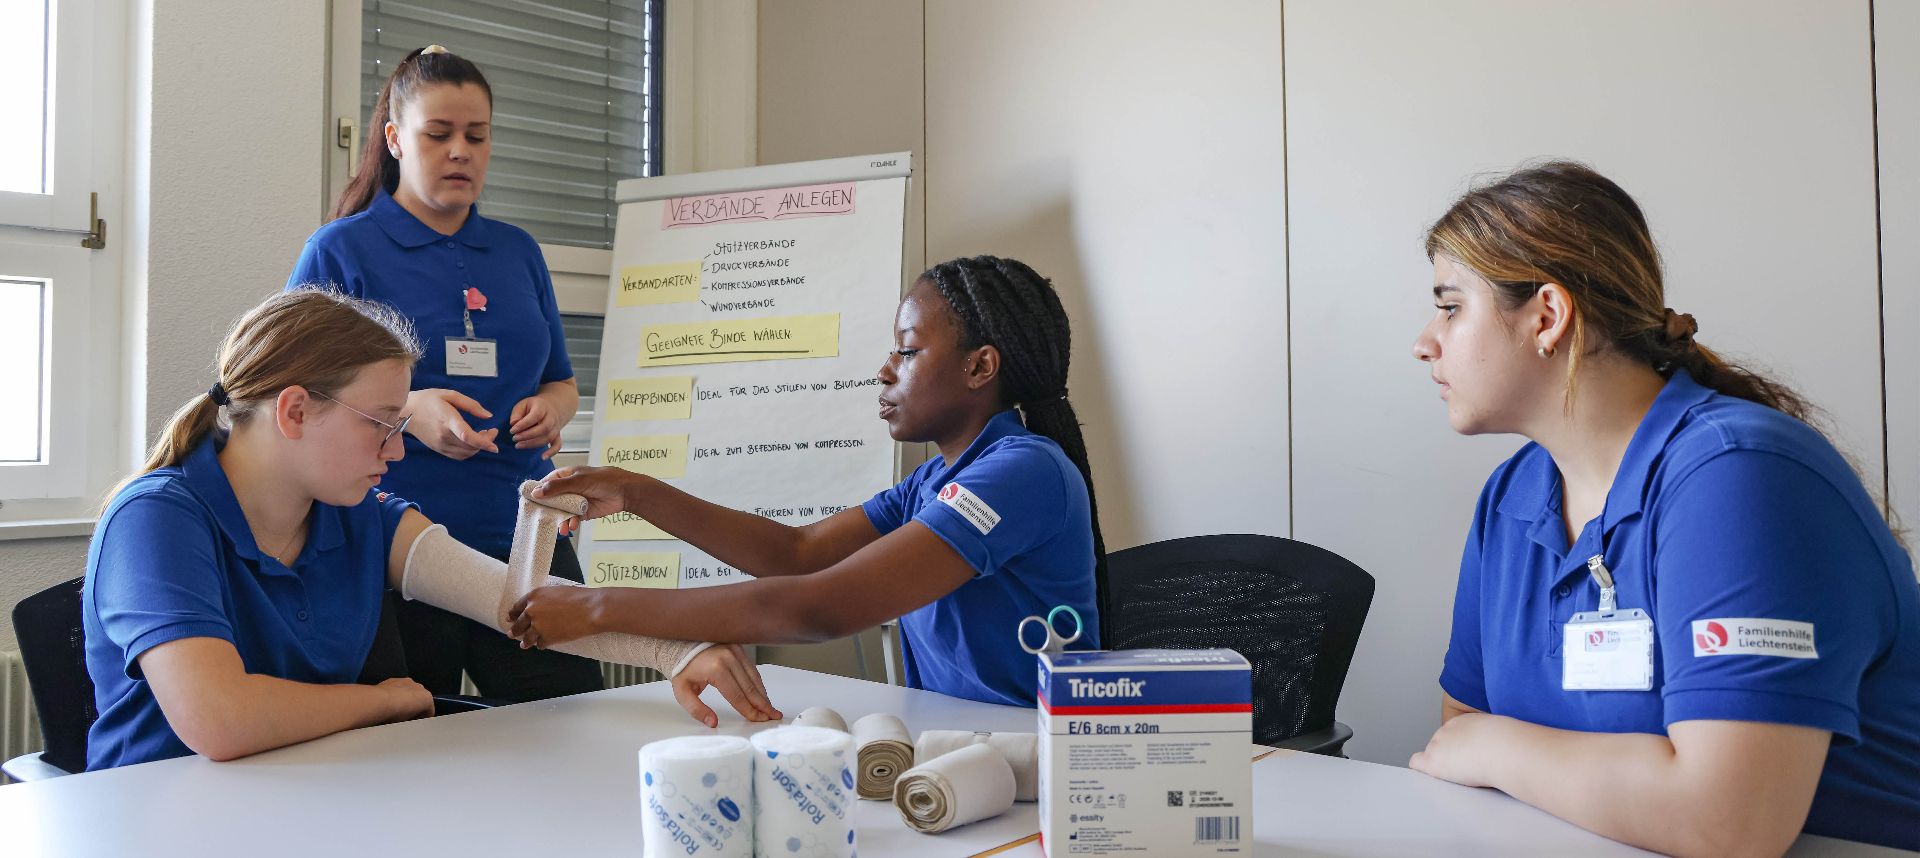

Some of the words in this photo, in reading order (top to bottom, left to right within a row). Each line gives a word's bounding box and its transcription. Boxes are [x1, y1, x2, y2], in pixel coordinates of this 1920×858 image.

[669, 197, 765, 221] VERBÄNDE
[777, 187, 853, 212] ANLEGEN
[713, 239, 796, 256] STÜTZVERBÄNDE
[711, 259, 790, 274] DRUCKVERBÄNDE
[622, 274, 697, 292] VERBANDARTEN:
[711, 276, 806, 291] KOMPRESSIONSVERBÄNDE
[710, 298, 775, 313] WUNDVERBÄNDE
[646, 332, 705, 353] GEEIGNETE
[709, 328, 747, 349] BINDE
[697, 386, 722, 401] IDEAL
[729, 386, 747, 397] FÜR
[752, 385, 770, 396] DAS
[774, 383, 807, 394] STILLEN
[811, 383, 827, 392] VON
[693, 447, 720, 461] IDEAL
[725, 446, 742, 456] ZUM
[795, 442, 809, 451] VON
[798, 507, 814, 517] VON
[955, 499, 991, 532] Liechtenstein
[960, 493, 996, 526] Familienhilfe
[685, 567, 711, 580] IDEAL
[717, 566, 732, 577] BEI
[1738, 626, 1812, 641] Familienhilfe
[1739, 639, 1814, 653] Liechtenstein
[1069, 721, 1091, 735] E/6
[1096, 723, 1120, 735] 8cm
[1124, 725, 1132, 734] x
[1135, 723, 1159, 735] 20m
